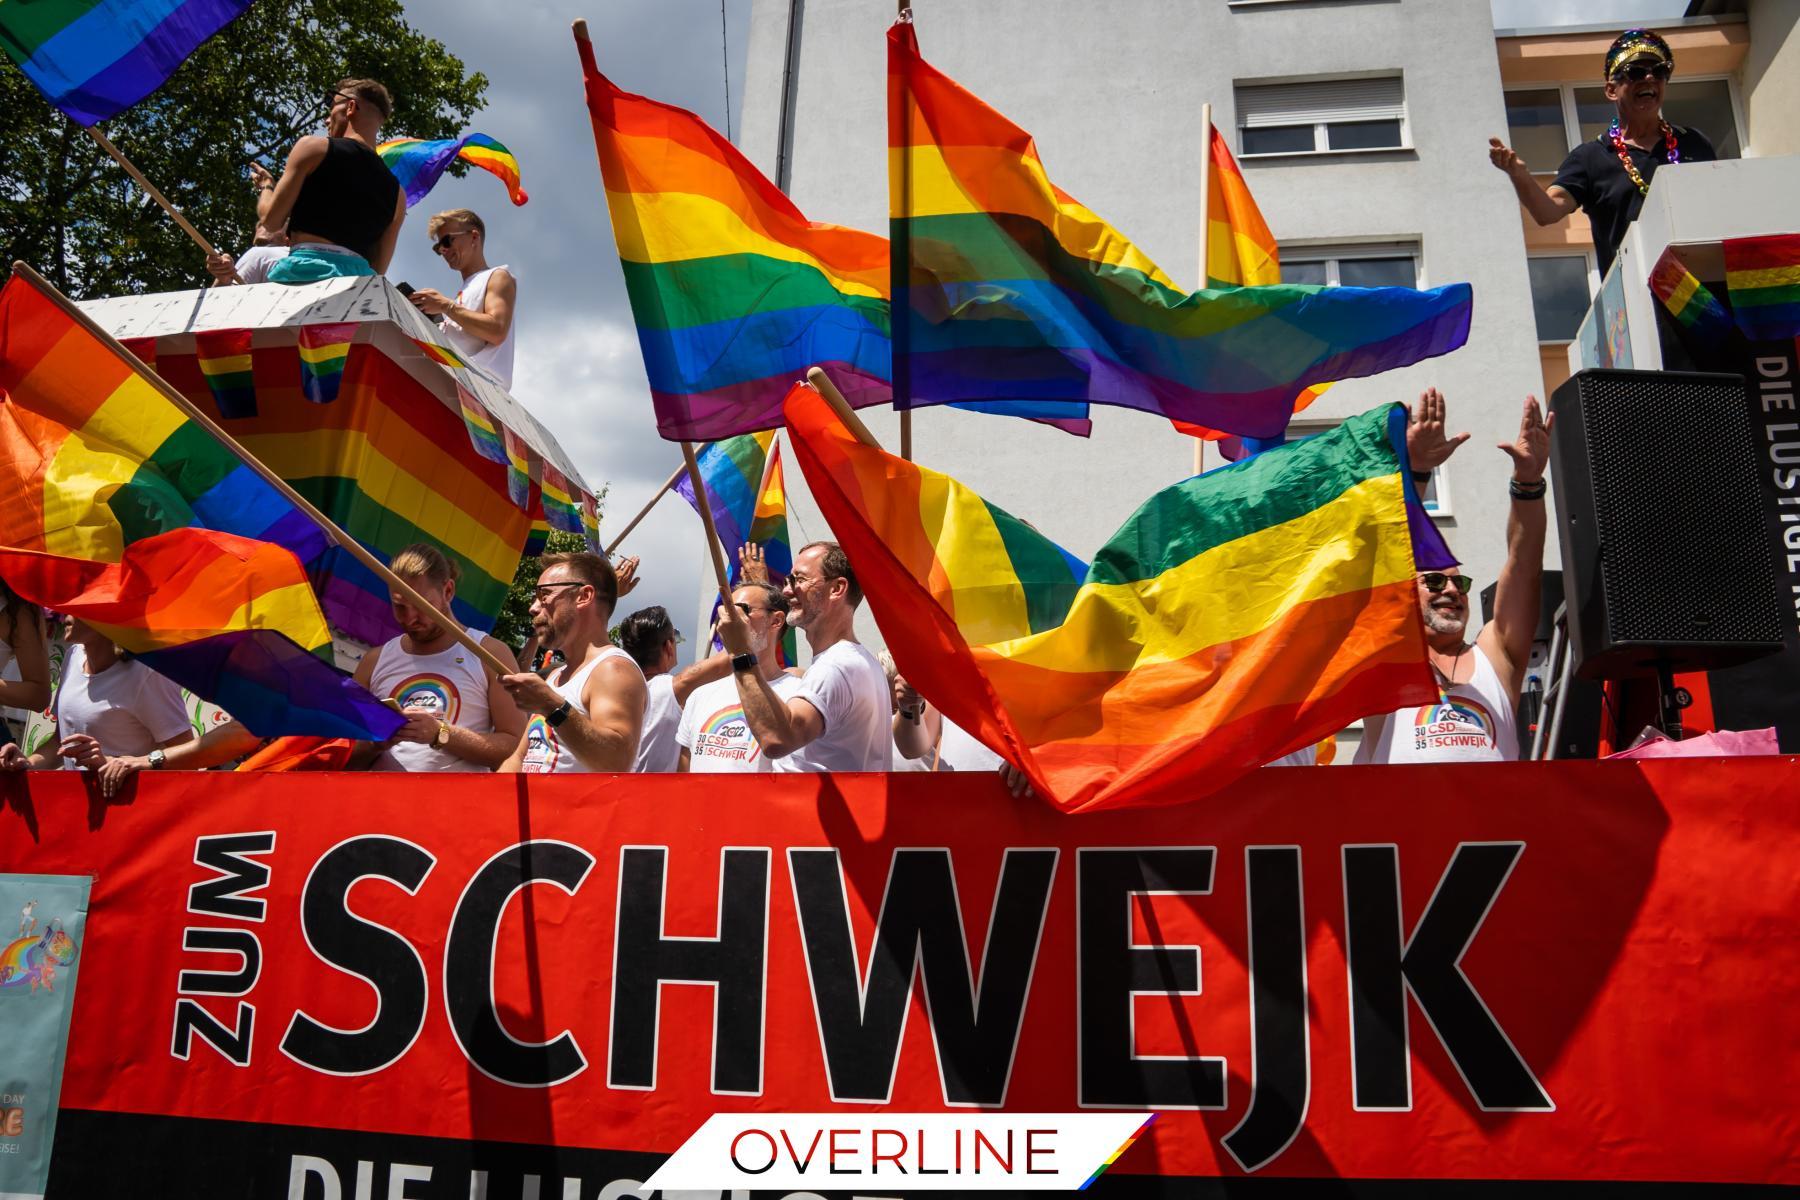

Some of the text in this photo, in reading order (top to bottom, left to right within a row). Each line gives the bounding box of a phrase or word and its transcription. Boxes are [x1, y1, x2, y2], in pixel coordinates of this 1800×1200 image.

[1756, 356, 1796, 412] DIE
[1415, 726, 1426, 737] 30
[1428, 722, 1456, 734] CSD
[707, 735, 729, 747] CSD
[1415, 740, 1427, 750] 35
[1434, 735, 1488, 748] SCHWEJK
[707, 747, 748, 761] SCHWEJK
[171, 830, 1557, 1173] ZUM SCHWEJK
[3, 1094, 25, 1105] DAY
